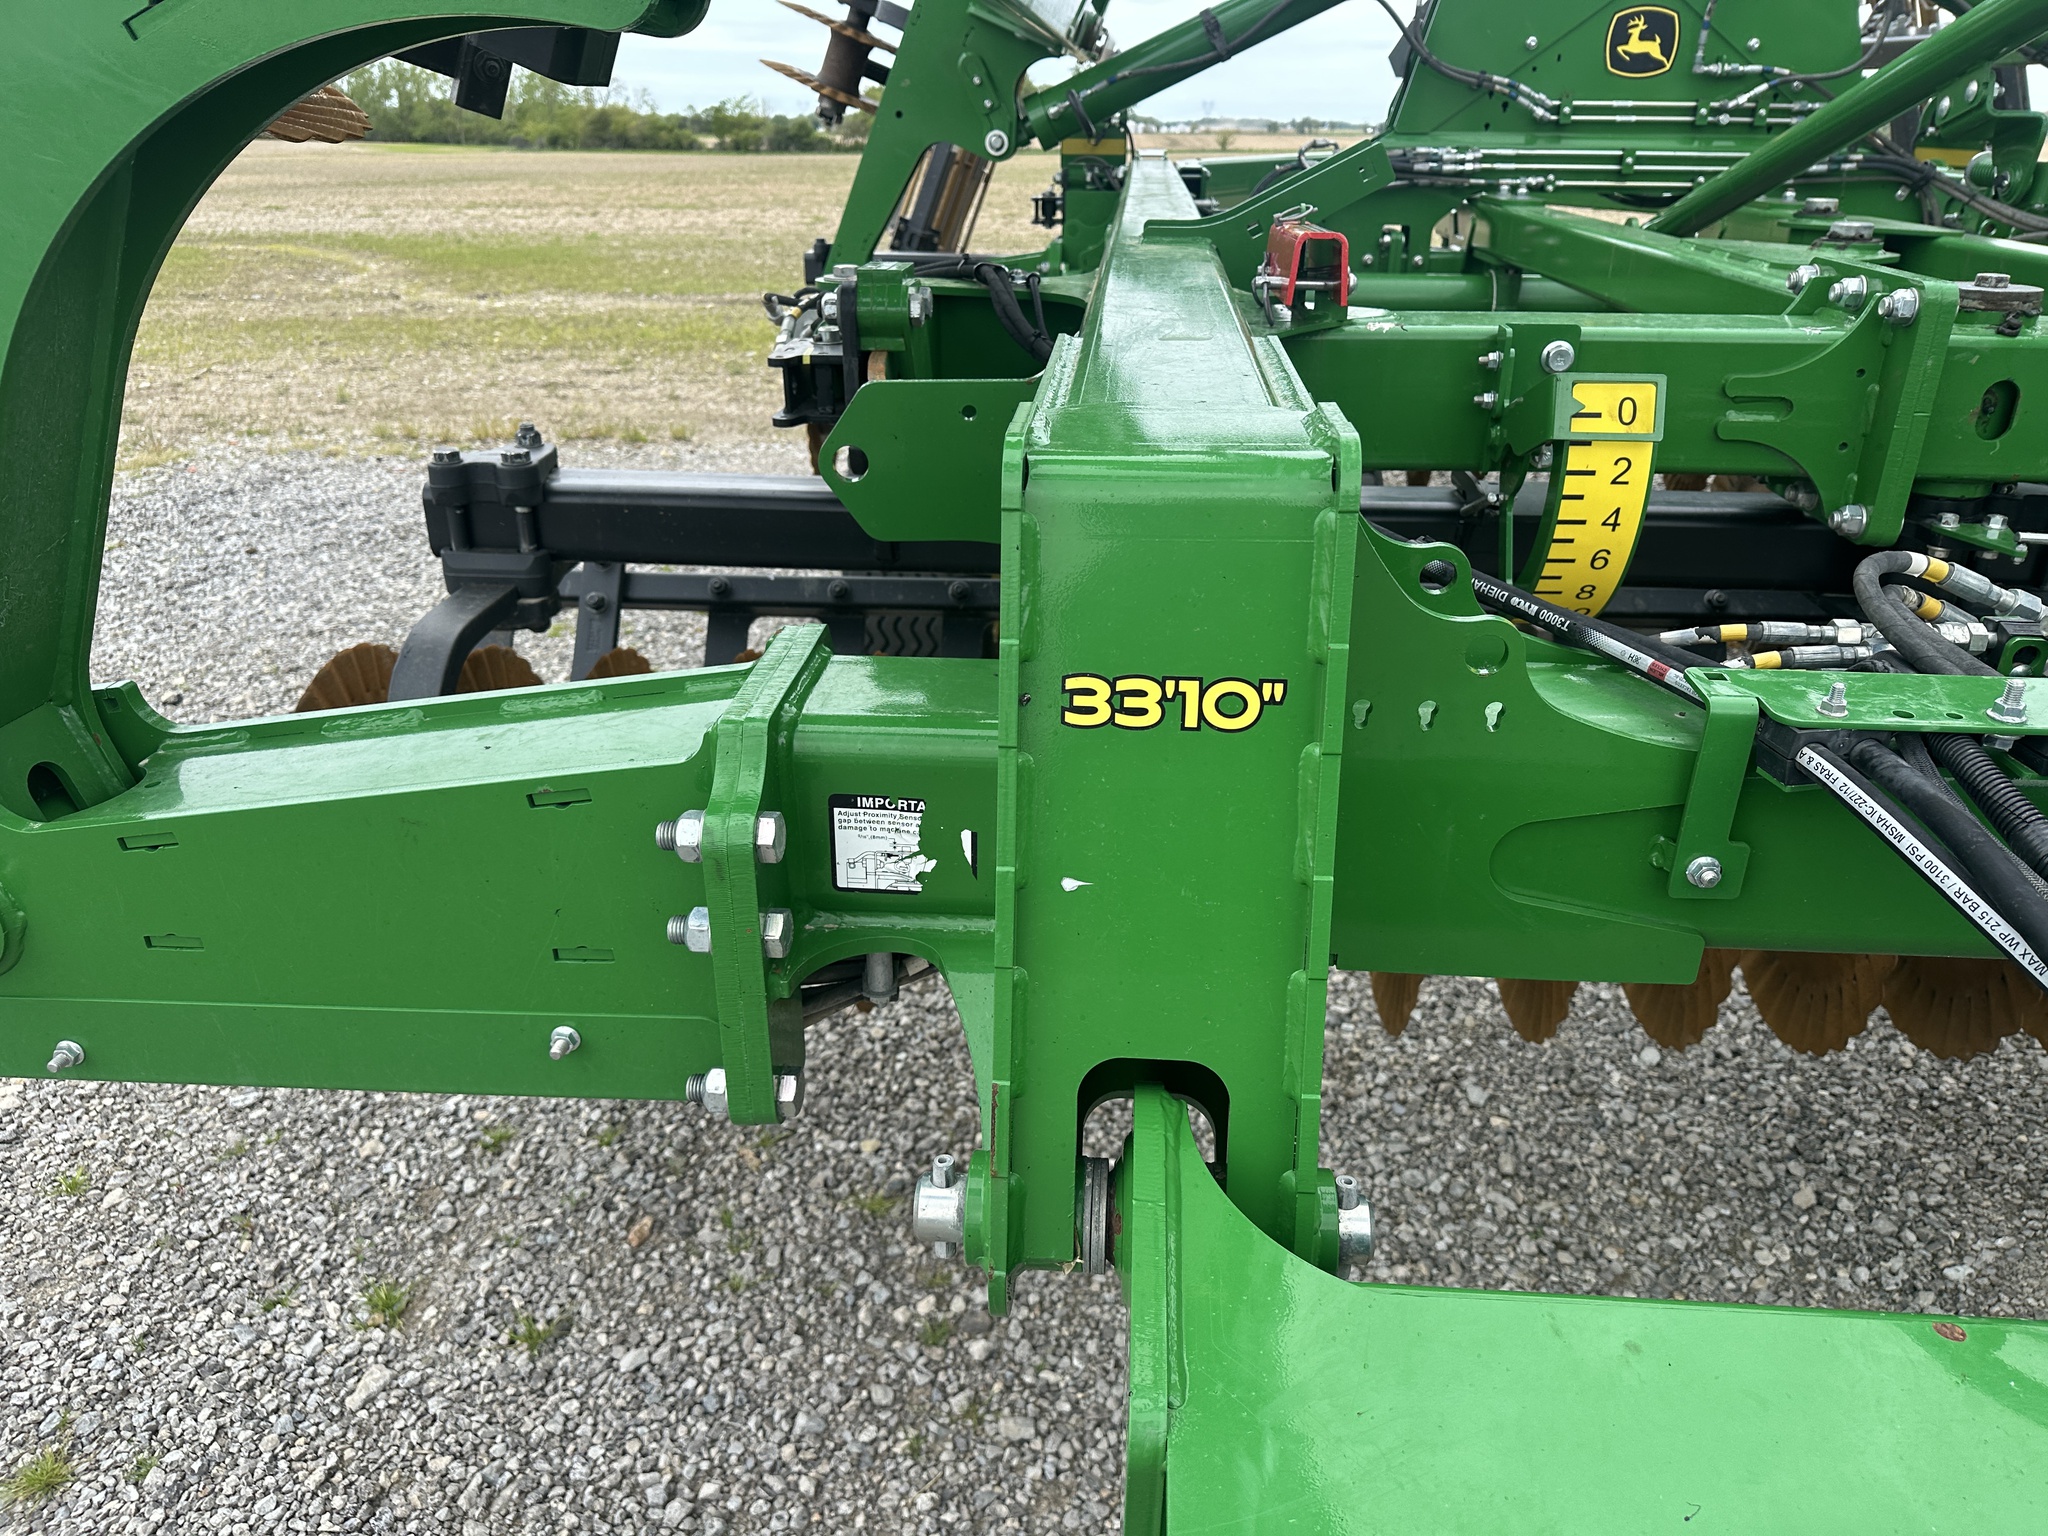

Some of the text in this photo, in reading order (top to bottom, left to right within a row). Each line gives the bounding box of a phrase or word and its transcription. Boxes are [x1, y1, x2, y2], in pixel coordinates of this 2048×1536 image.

[1618, 397, 1637, 426] 0
[1610, 457, 1632, 485] 2
[1601, 507, 1621, 532] 4
[1590, 549, 1611, 570] 6
[1471, 578, 1509, 603] DIEHA
[1575, 584, 1597, 600] 8
[1538, 609, 1571, 632] T3000
[1061, 673, 1288, 733] 33'10"
[1799, 749, 1808, 760] A
[1807, 756, 1815, 766] &
[1813, 761, 1839, 785] FRAS
[1838, 782, 1878, 818] IC-227/12
[837, 810, 861, 818] Adjust
[863, 811, 897, 820] Proximity
[854, 817, 885, 825] between
[837, 824, 868, 832] damage
[1875, 814, 1906, 844] MSHA
[1905, 842, 1926, 862] PSI
[1923, 859, 1950, 884] 3100
[1953, 886, 1981, 913] BAR
[1977, 911, 2002, 932] 215
[1998, 931, 2021, 951] WP
[2018, 948, 2048, 977] MAX
